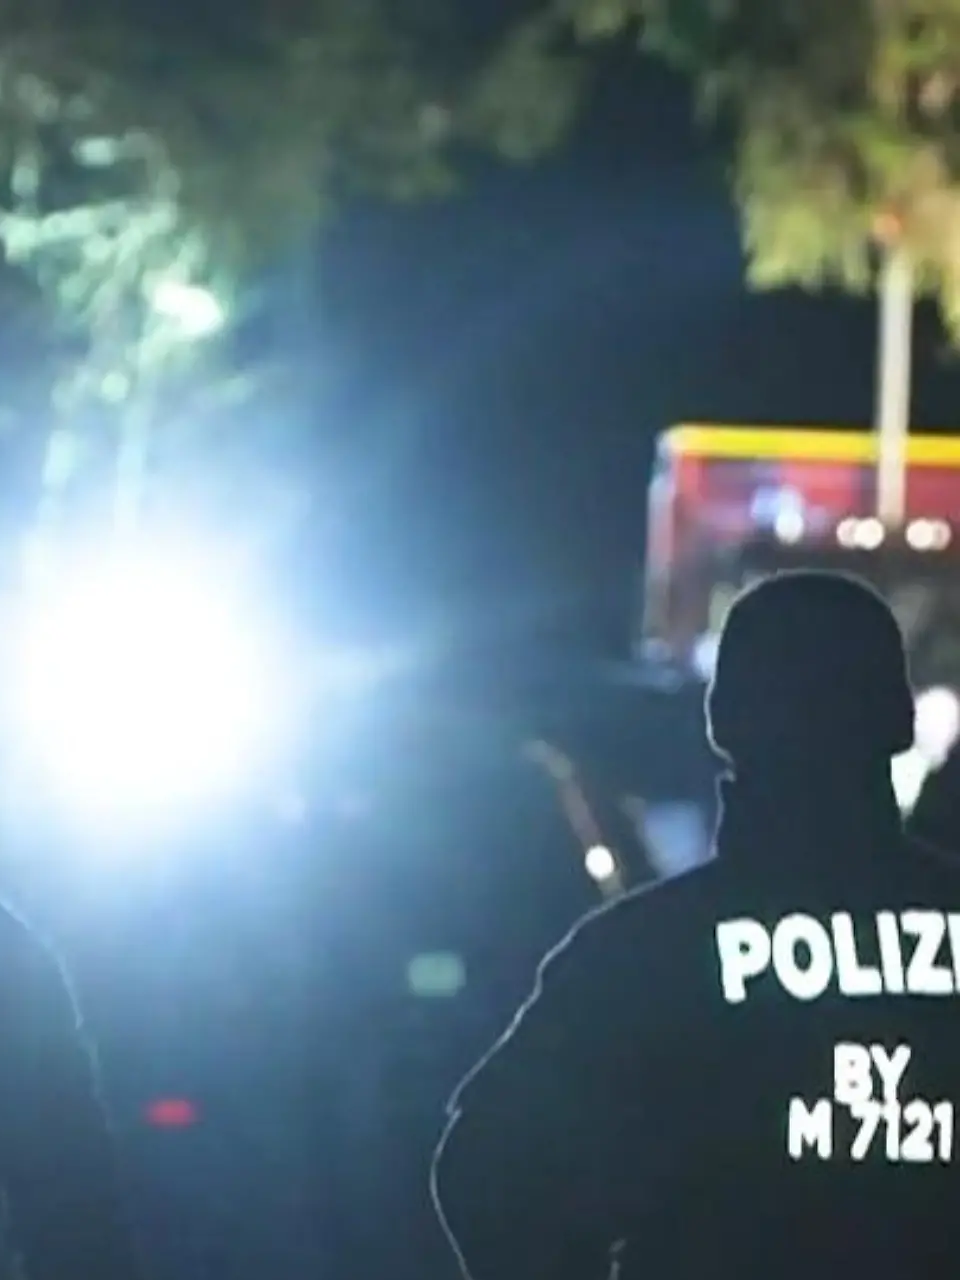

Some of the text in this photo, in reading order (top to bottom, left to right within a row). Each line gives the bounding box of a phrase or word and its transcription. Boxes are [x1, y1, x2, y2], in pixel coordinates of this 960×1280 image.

[715, 910, 960, 1004] POLIZ
[833, 1042, 912, 1104] BY
[787, 1096, 954, 1162] M 7121
